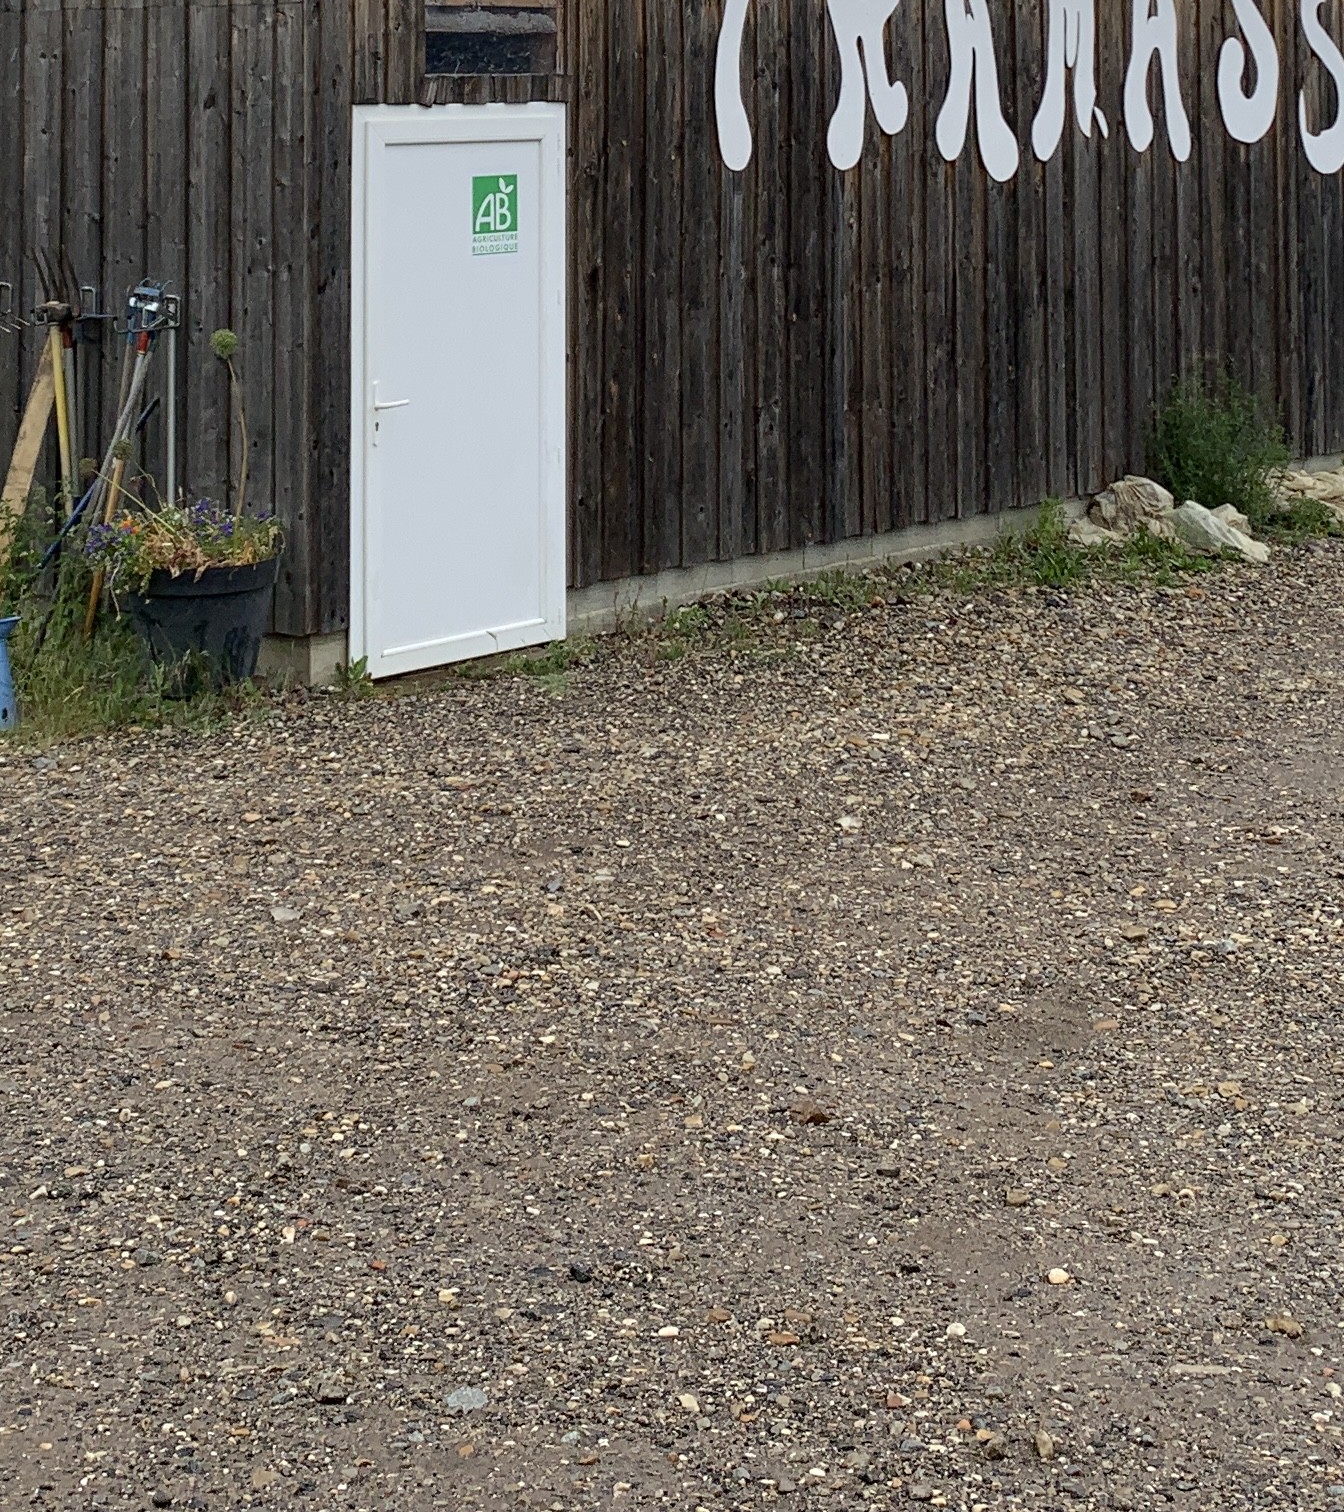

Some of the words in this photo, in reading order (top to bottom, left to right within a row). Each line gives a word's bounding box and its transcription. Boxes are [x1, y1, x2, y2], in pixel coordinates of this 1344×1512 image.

[475, 192, 512, 232] AB
[472, 233, 518, 243] AGRICULTURE
[472, 243, 518, 253] BIOLOGIQUE
